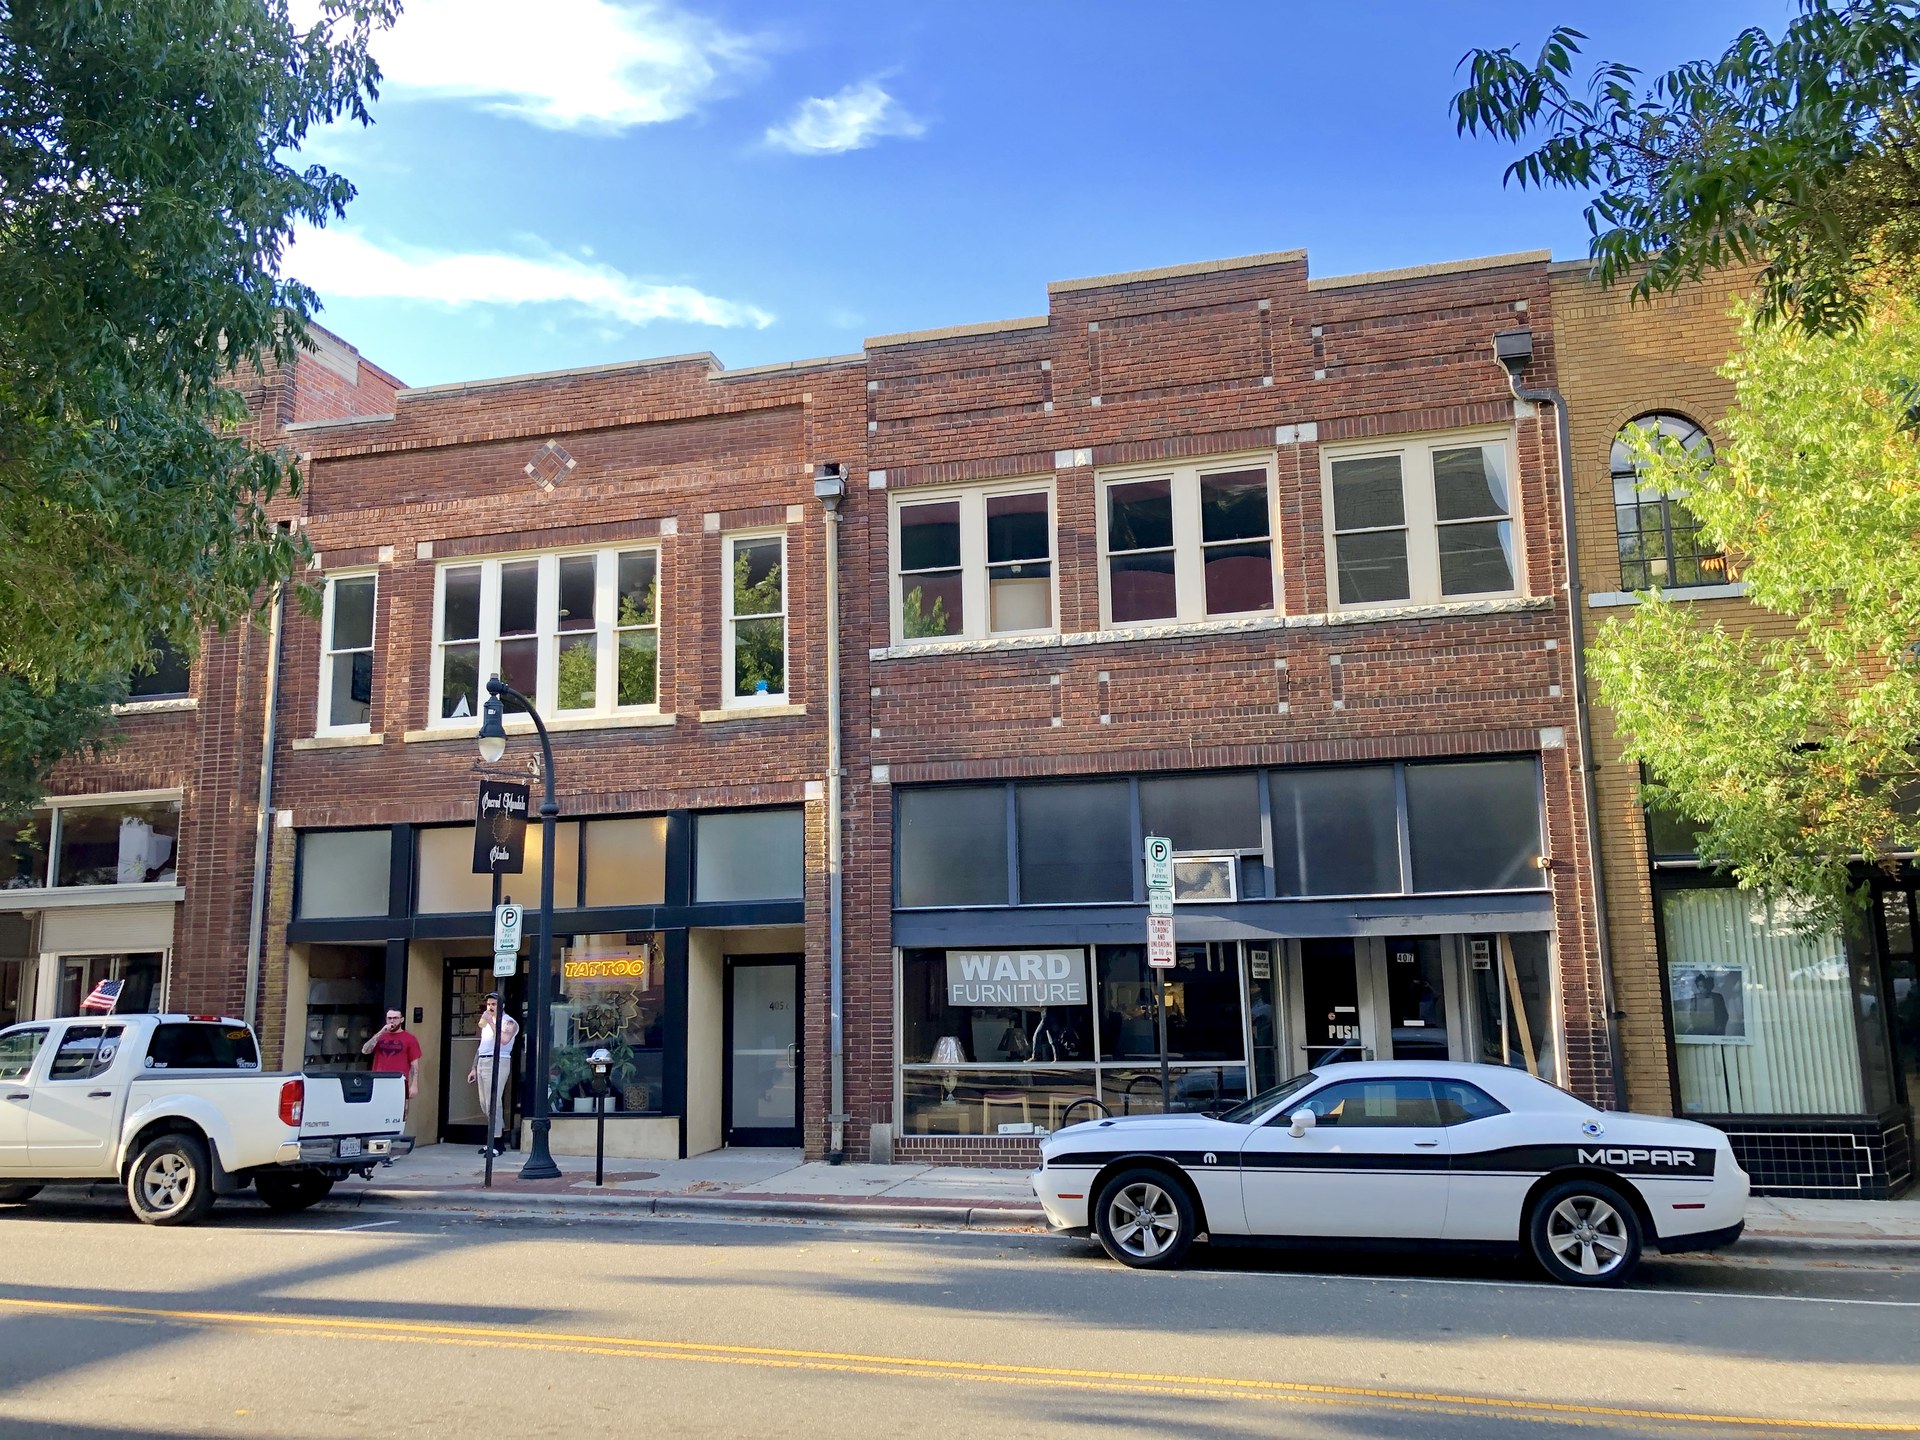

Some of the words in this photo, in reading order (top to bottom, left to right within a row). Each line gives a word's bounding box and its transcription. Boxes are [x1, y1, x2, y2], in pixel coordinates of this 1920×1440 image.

[490, 845, 509, 870] Studio
[1155, 845, 1163, 858] P
[506, 912, 514, 924] P
[1254, 952, 1267, 960] WARD
[1397, 953, 1414, 962] 407
[565, 960, 644, 977] TATTOO
[959, 953, 1071, 981] WARD
[952, 983, 1081, 1002] FURNITURE
[1329, 1025, 1359, 1039] PUSH
[1577, 1148, 1696, 1166] MOPAR
